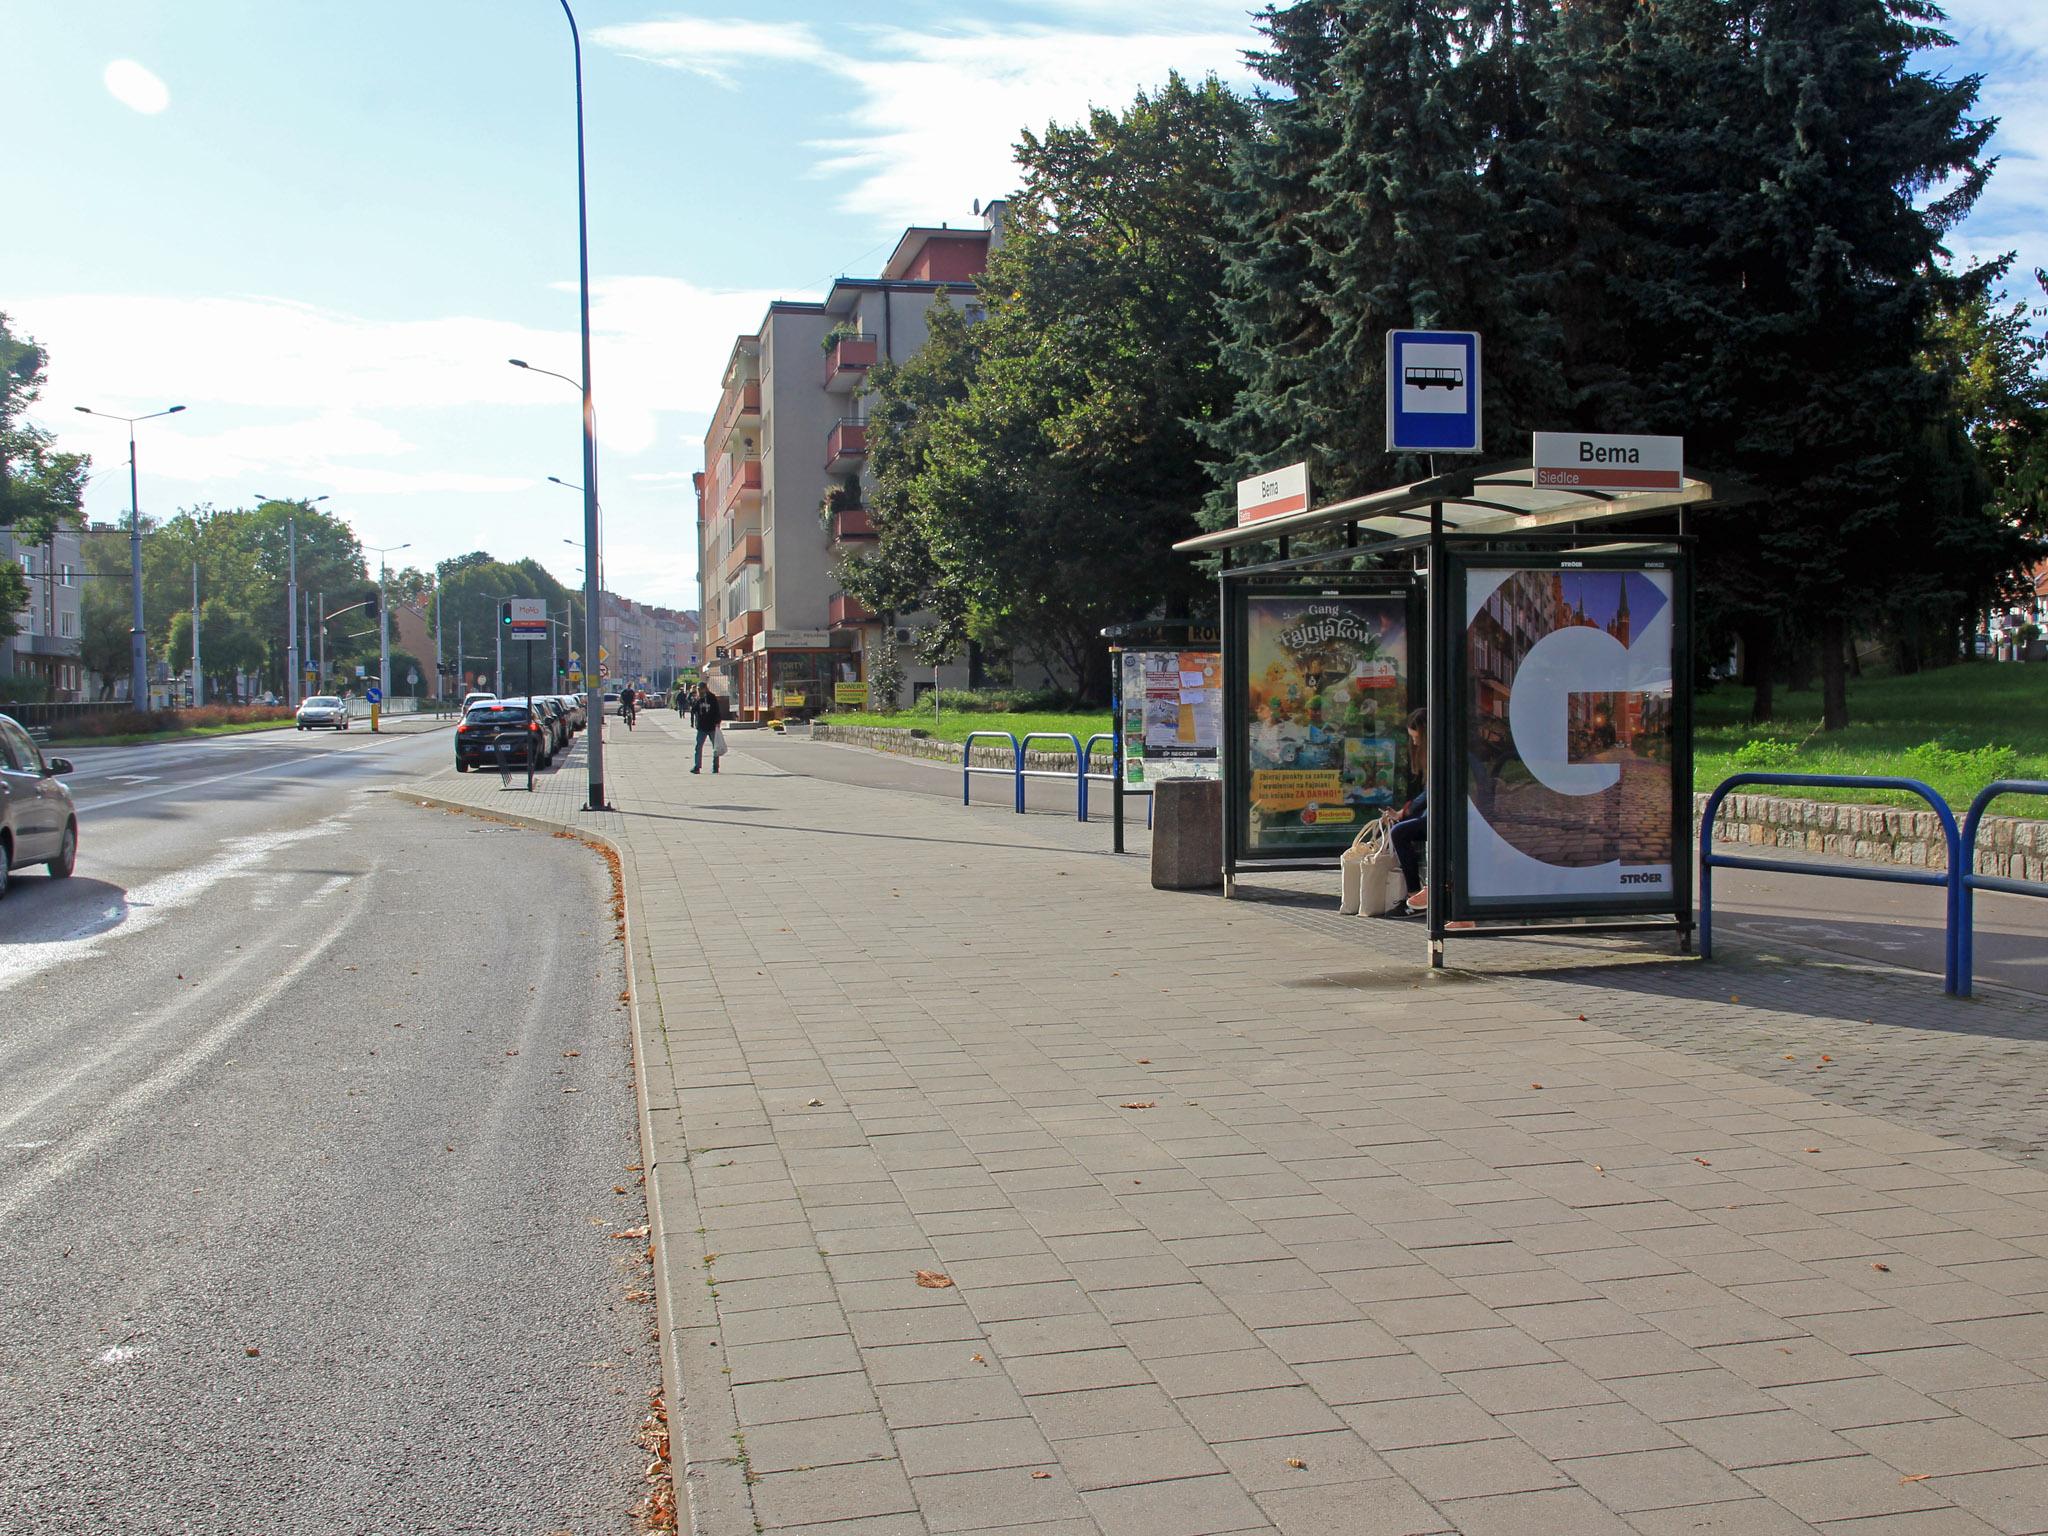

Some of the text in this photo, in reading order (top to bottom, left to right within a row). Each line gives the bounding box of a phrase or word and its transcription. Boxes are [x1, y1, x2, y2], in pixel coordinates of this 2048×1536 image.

[1579, 441, 1640, 464] Bema
[1539, 471, 1579, 484] Siedlce
[1261, 481, 1279, 498] Bema
[1308, 604, 1339, 616] Gang
[1280, 617, 1382, 648] Fajniaków
[1295, 790, 1305, 798] ZA
[1619, 872, 1662, 884] STRÖER
